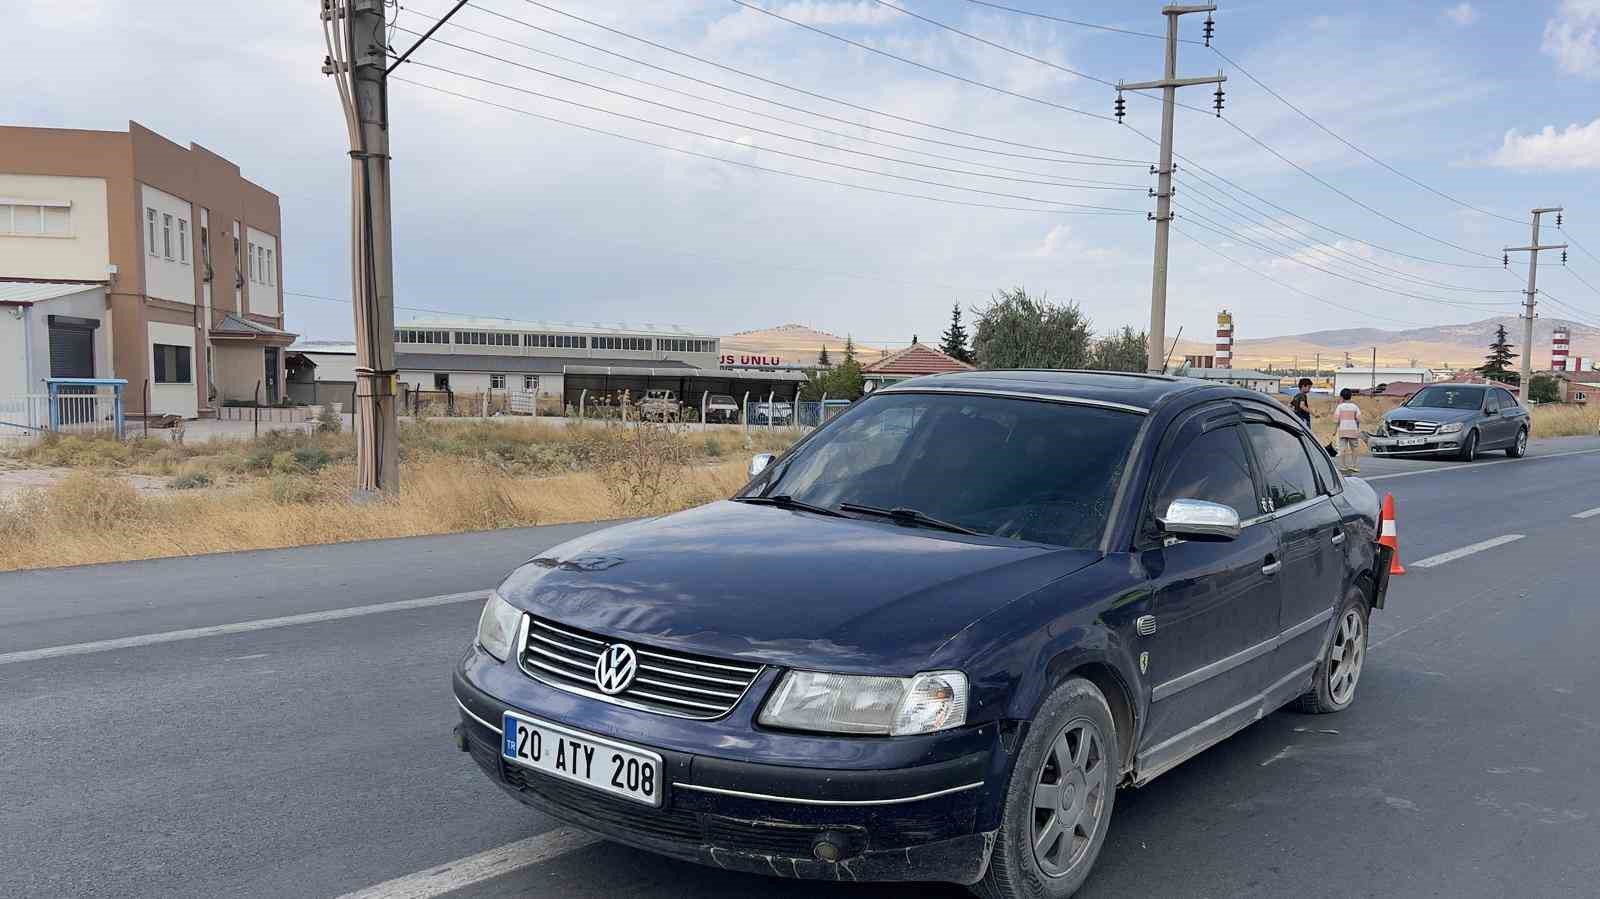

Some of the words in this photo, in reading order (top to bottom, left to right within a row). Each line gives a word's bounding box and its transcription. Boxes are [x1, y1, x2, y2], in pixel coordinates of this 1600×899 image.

[596, 644, 636, 694] VW
[506, 739, 516, 750] TR
[518, 726, 542, 762] 20
[556, 738, 595, 779] ATY
[611, 754, 655, 796] 208
